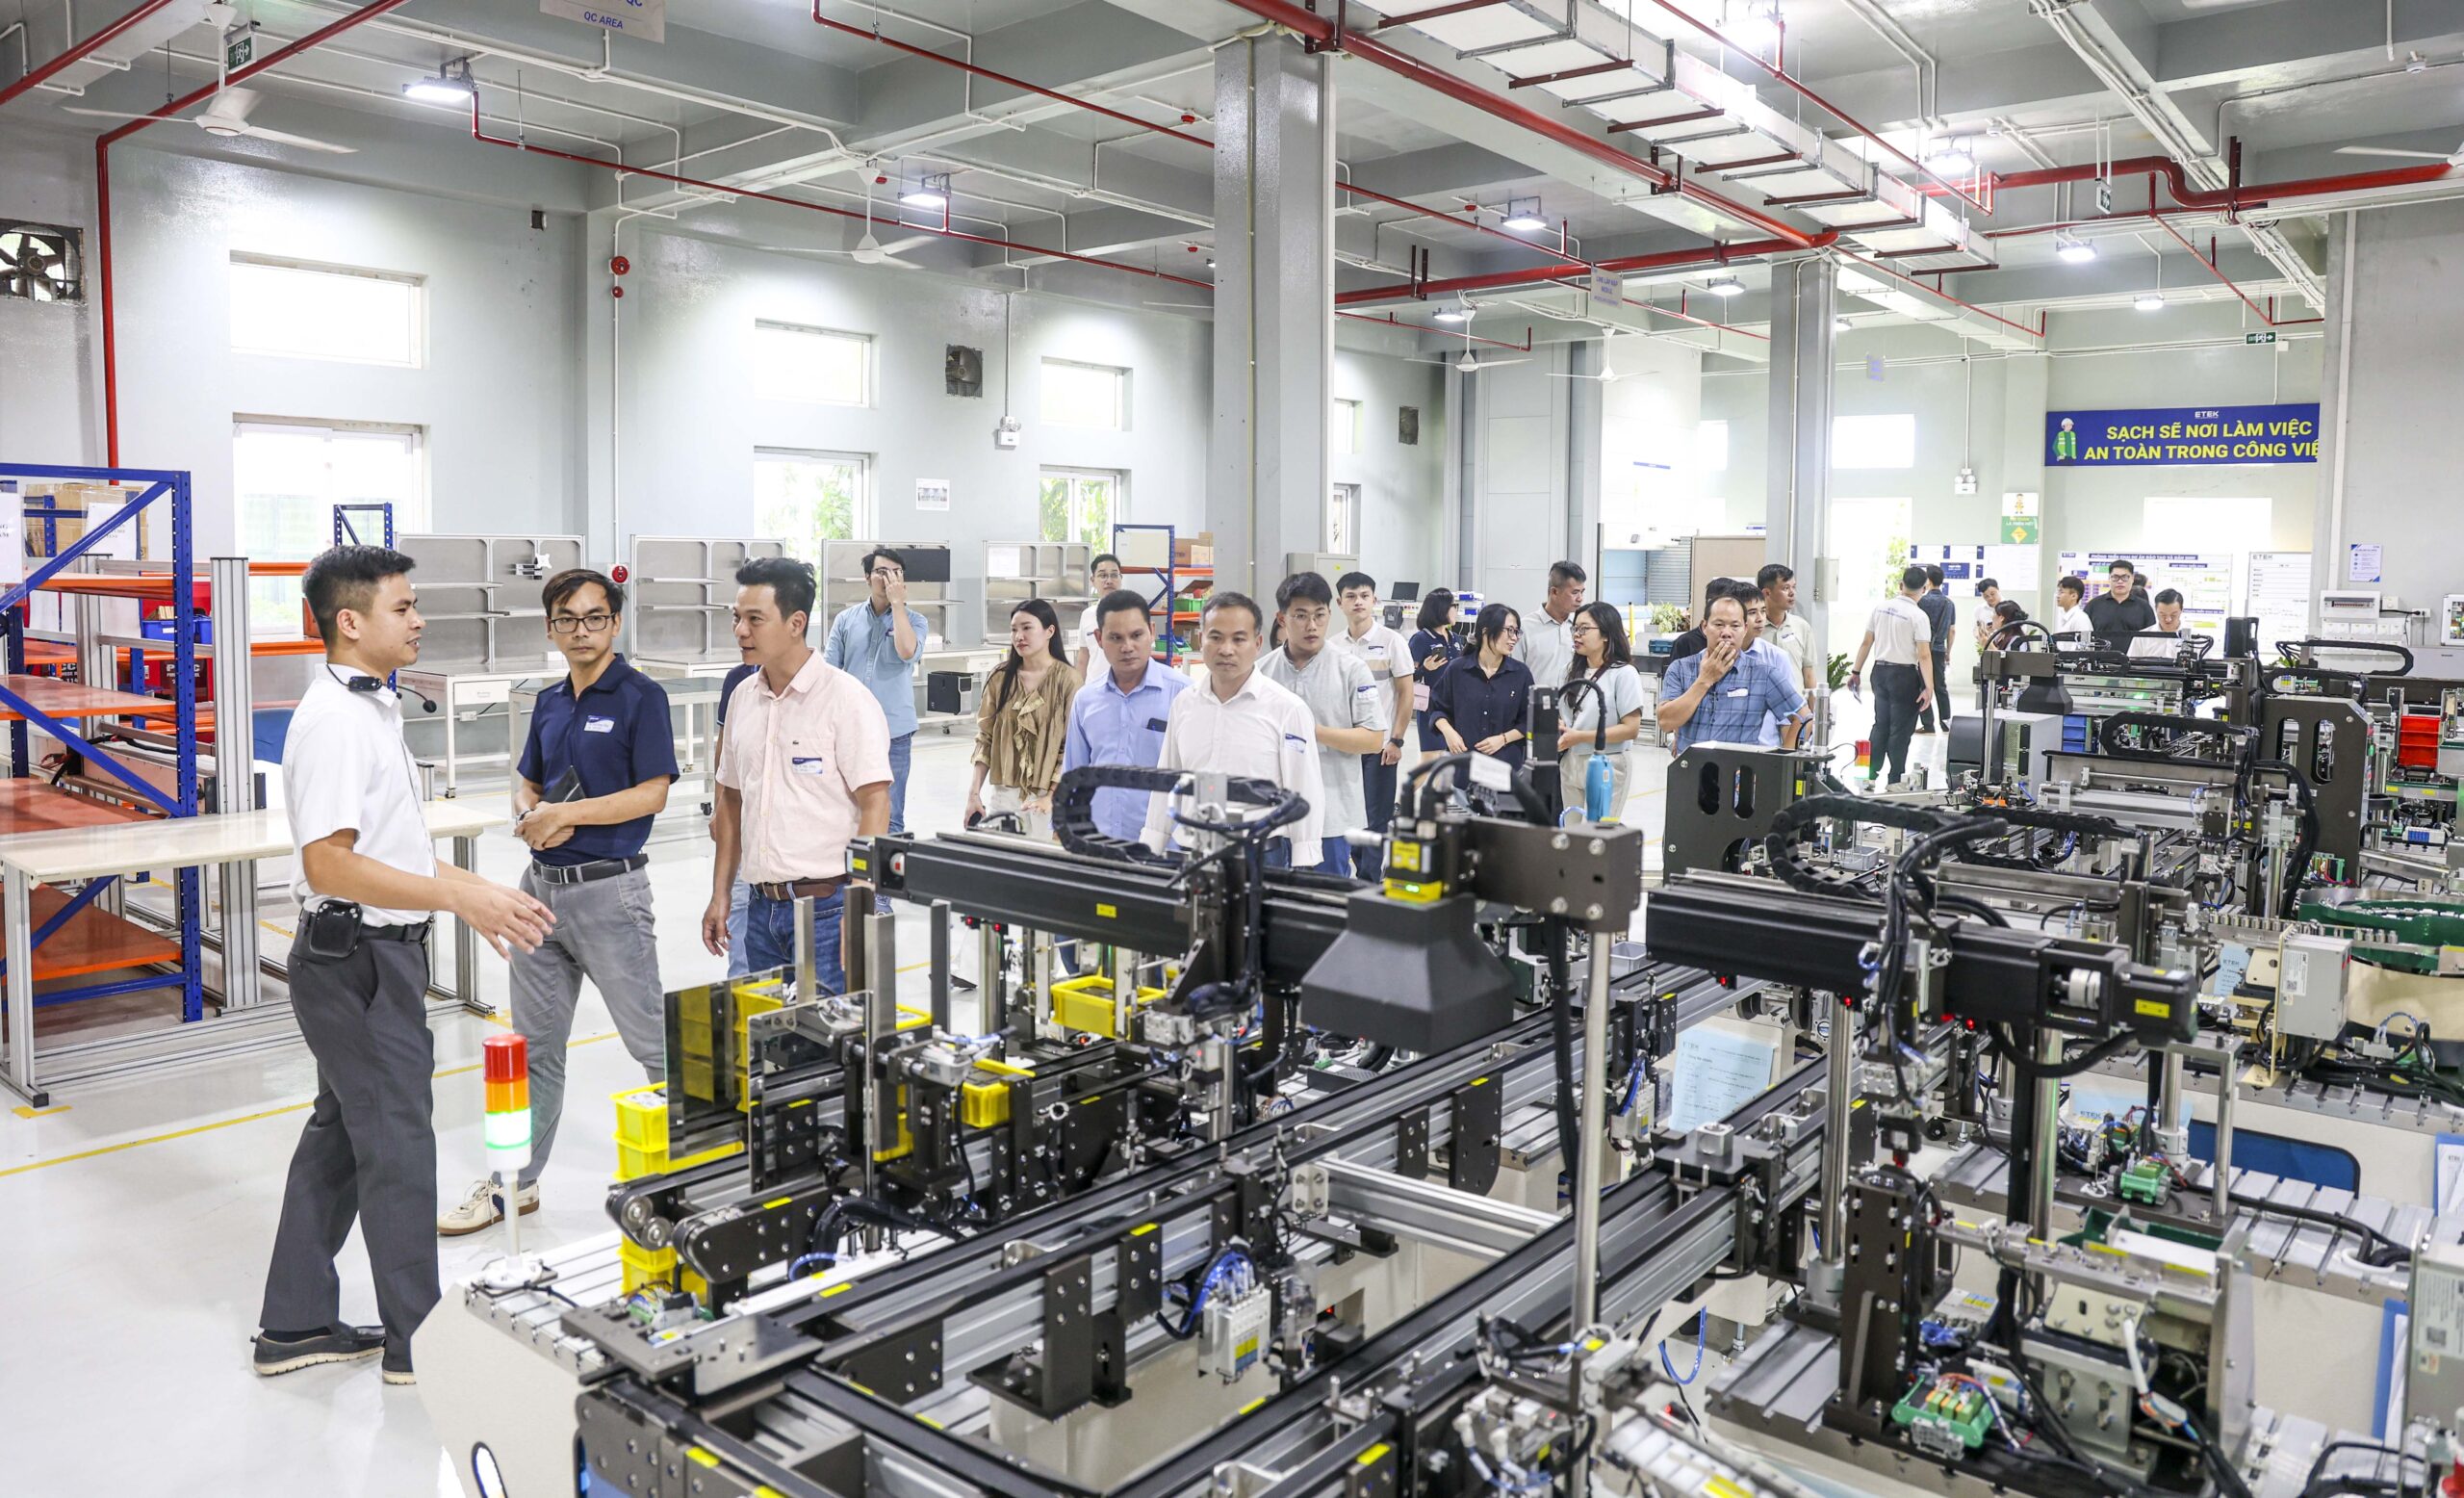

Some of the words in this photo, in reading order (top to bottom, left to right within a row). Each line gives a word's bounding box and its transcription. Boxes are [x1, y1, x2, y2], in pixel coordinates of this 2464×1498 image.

[584, 12, 598, 22] QC
[599, 15, 624, 29] AREA
[2107, 425, 2154, 442] SẠCH
[2159, 422, 2182, 439] SẼ
[2186, 423, 2217, 439] NƠI
[2222, 420, 2263, 438] LÀM
[2269, 418, 2313, 439] VIỆC
[2084, 447, 2109, 460] AN
[2113, 443, 2161, 460] TOÀN
[2166, 443, 2228, 459] TRONG
[2233, 440, 2286, 458] CÔNG
[2292, 441, 2319, 459] VIỆ
[2080, 1110, 2102, 1119] ETEK
